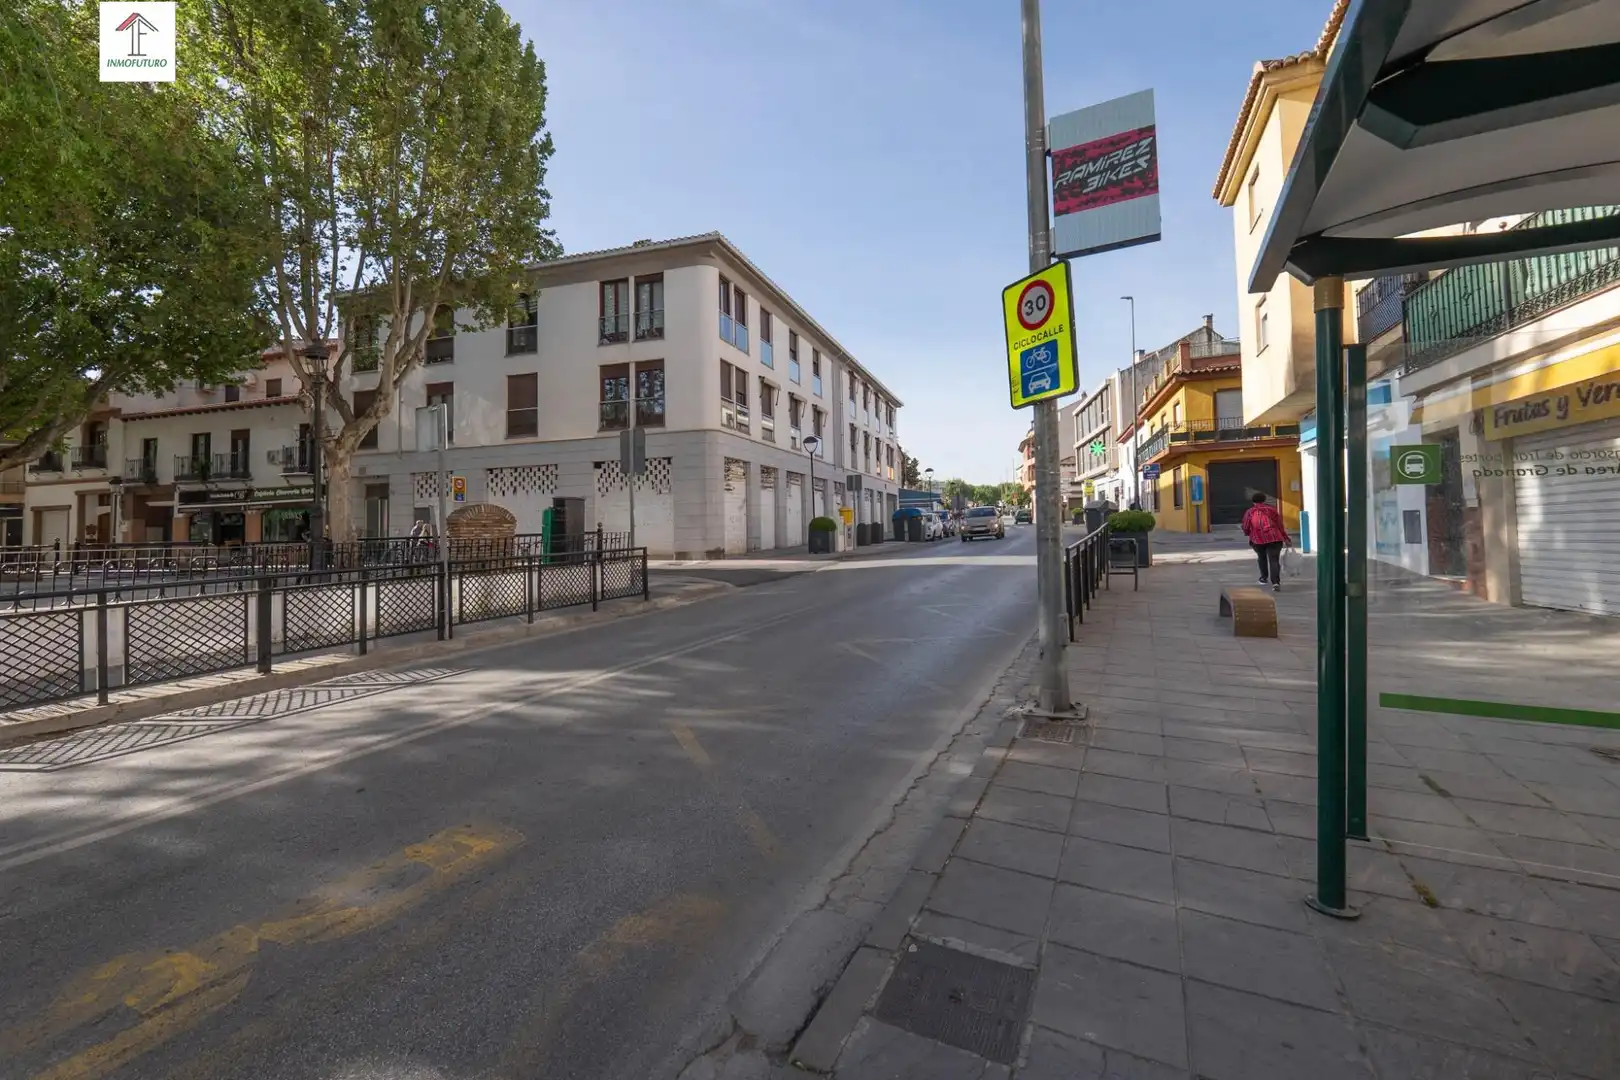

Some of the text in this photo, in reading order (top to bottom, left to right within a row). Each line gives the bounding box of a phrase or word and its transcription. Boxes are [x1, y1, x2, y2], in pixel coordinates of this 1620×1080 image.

[1054, 136, 1154, 190] RAMIREZ
[1082, 154, 1152, 194] BIKES
[1024, 294, 1047, 317] 30
[1013, 323, 1065, 351] CICLOCALLE
[1493, 398, 1551, 429] Frutas
[1556, 395, 1570, 420] y
